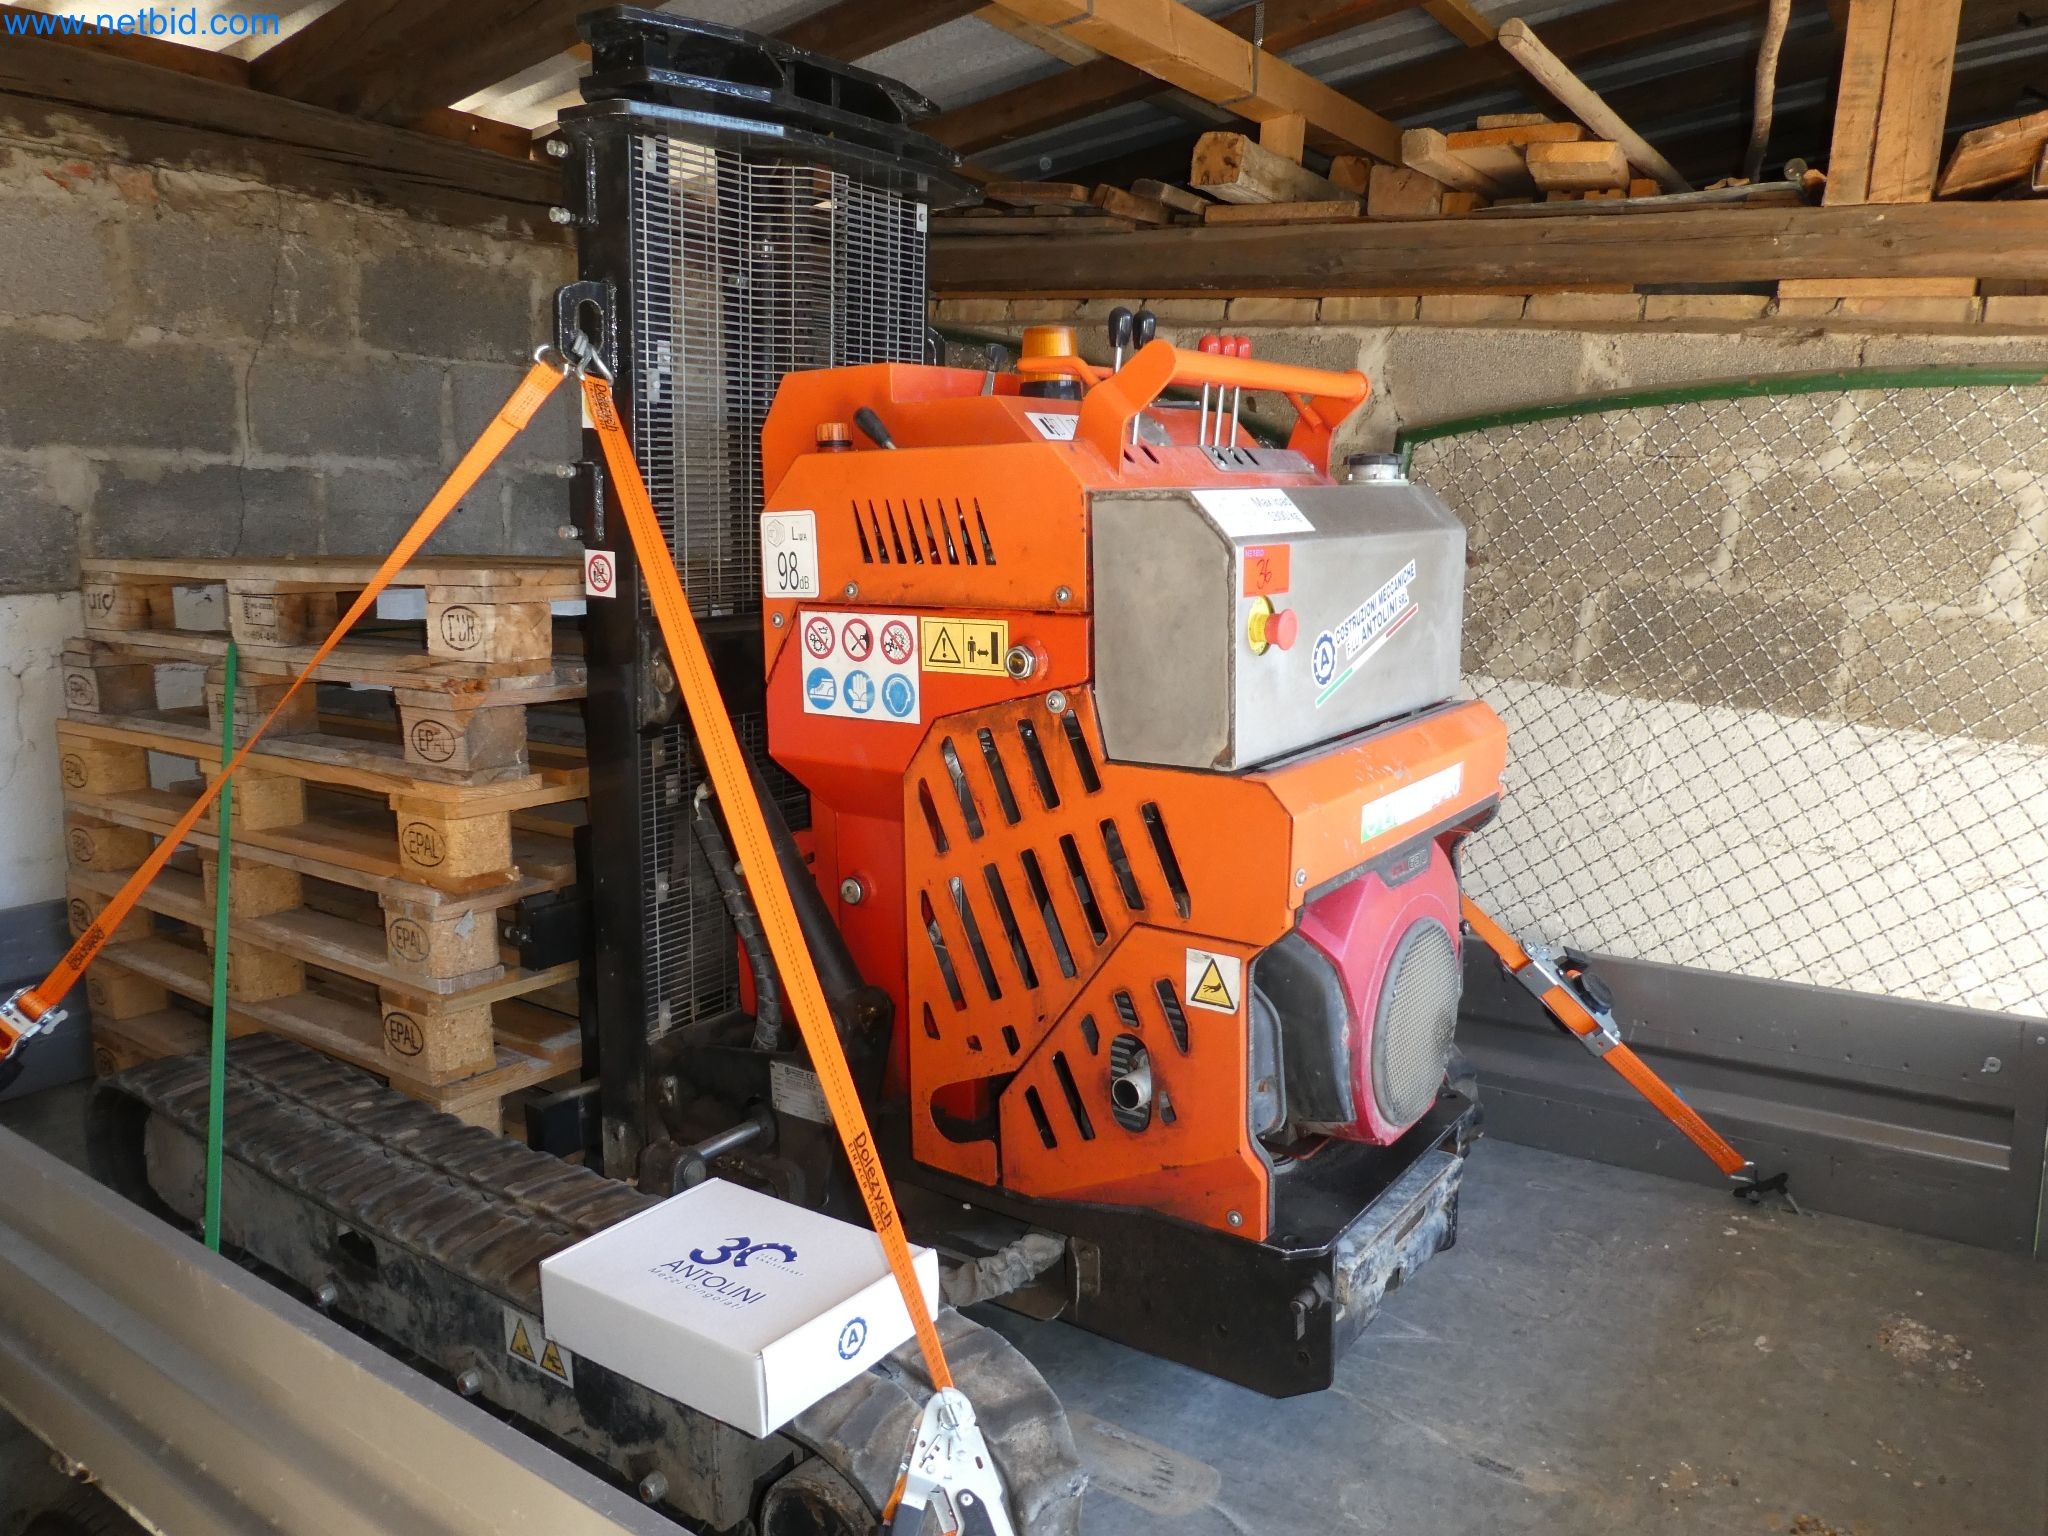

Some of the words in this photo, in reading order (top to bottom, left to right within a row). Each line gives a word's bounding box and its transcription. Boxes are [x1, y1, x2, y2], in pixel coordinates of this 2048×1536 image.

[777, 551, 799, 590] 98
[1335, 598, 1377, 645] COSTRUZIONI
[1377, 562, 1415, 604] MECCANICHE
[1361, 597, 1398, 644] ANTOLINI
[447, 614, 476, 642] EUR
[417, 728, 450, 755] EPAL
[408, 830, 440, 859] EPAL
[396, 926, 425, 956] EPAL
[390, 1020, 420, 1051] EPAL
[855, 1131, 893, 1228] Dolezych
[648, 1267, 684, 1286] Mezzi
[685, 1282, 746, 1311] Cingolati
[661, 1259, 768, 1305] ANTOLINI
[847, 1328, 859, 1349] A
